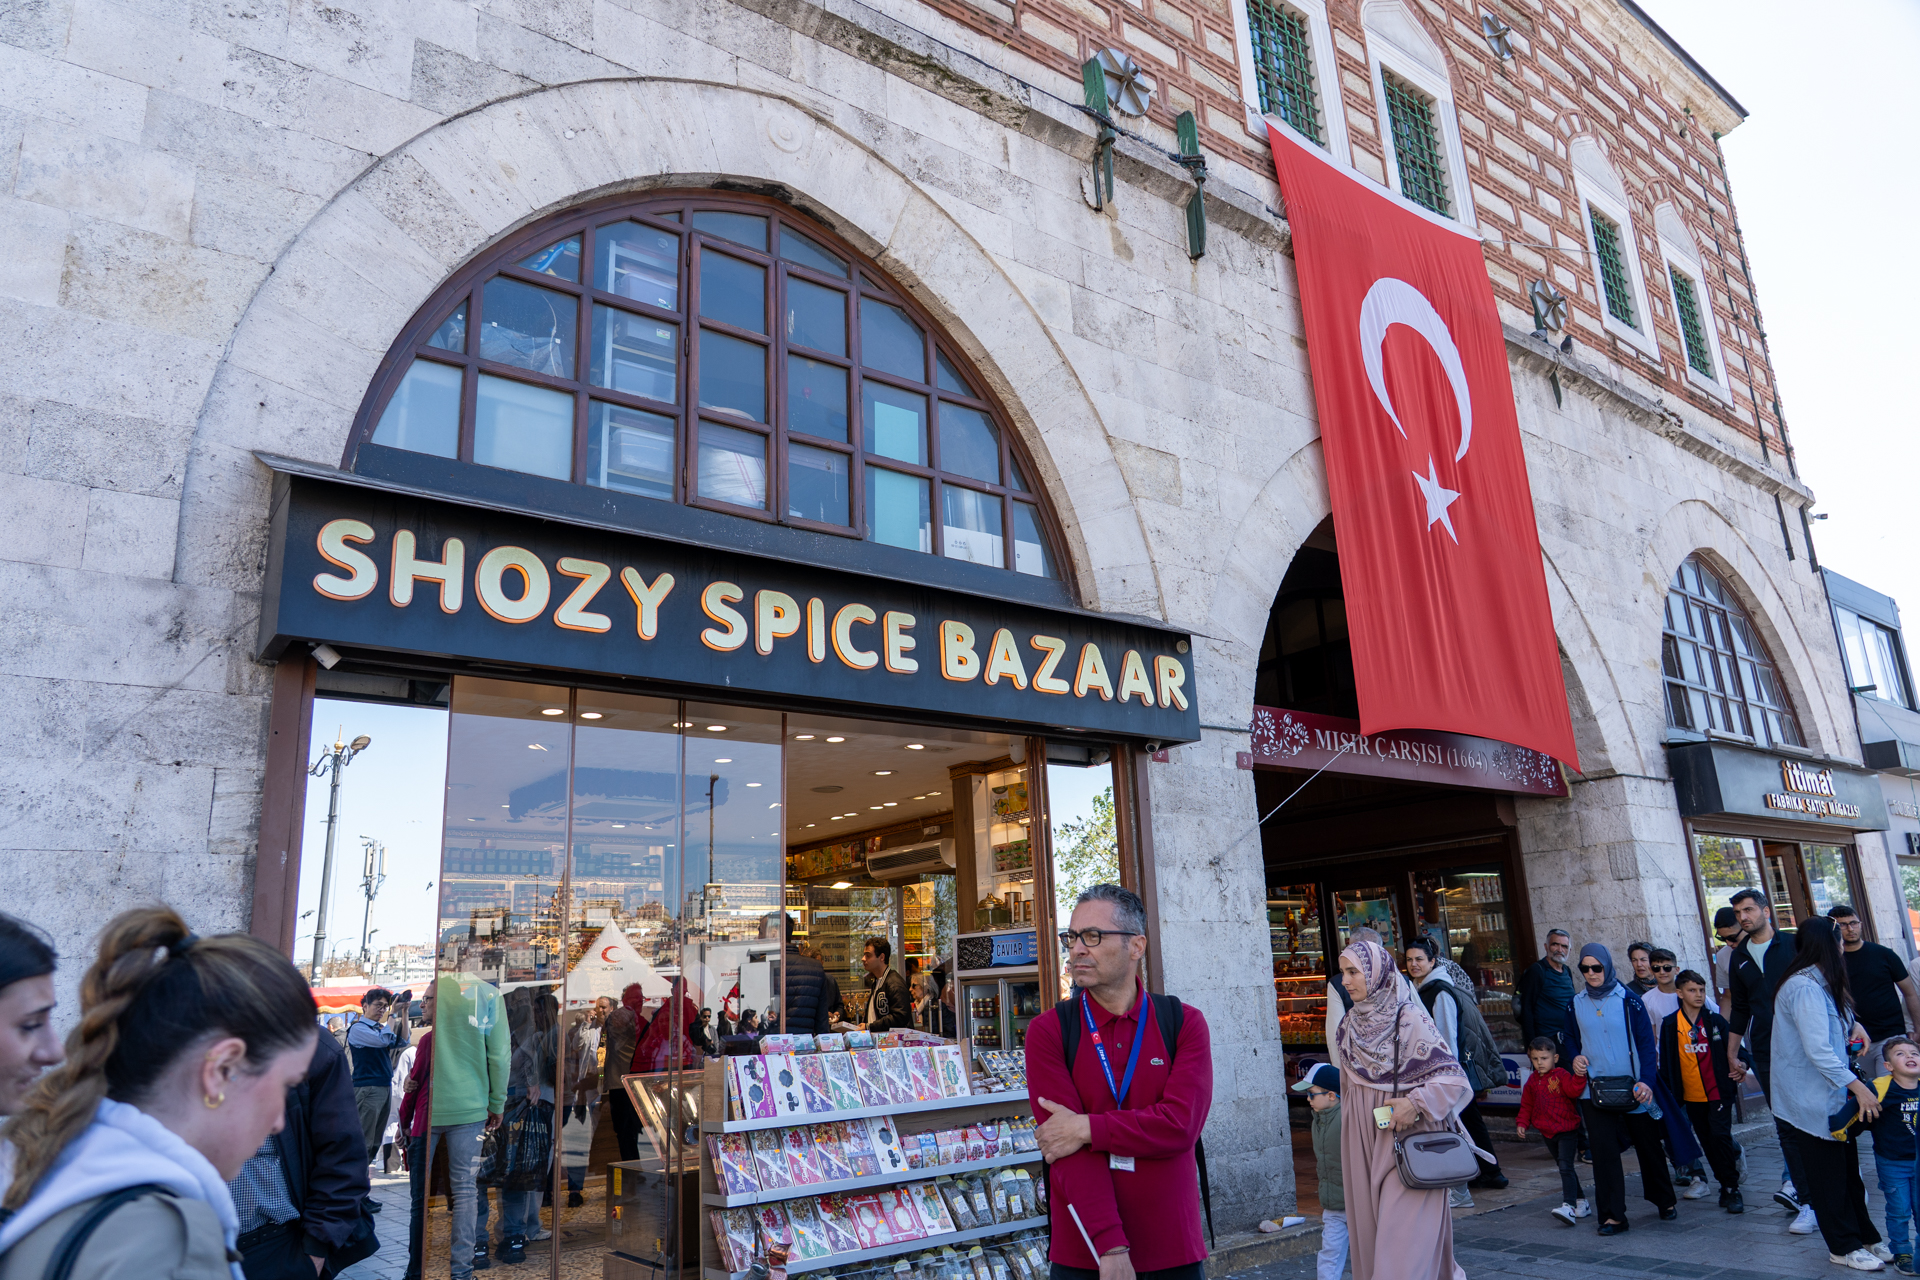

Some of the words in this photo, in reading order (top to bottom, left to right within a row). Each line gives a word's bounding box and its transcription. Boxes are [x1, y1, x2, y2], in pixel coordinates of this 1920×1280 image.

[312, 518, 676, 640] SHOZY
[701, 580, 919, 675] SPICE
[939, 619, 1189, 711] BAZAAR
[1313, 728, 1371, 756] MISIR
[1375, 737, 1443, 767] ÇARŞISI
[1447, 747, 1489, 776] (1664)
[996, 943, 1023, 957] CAVIAR
[1684, 1043, 1708, 1053] SIXT
